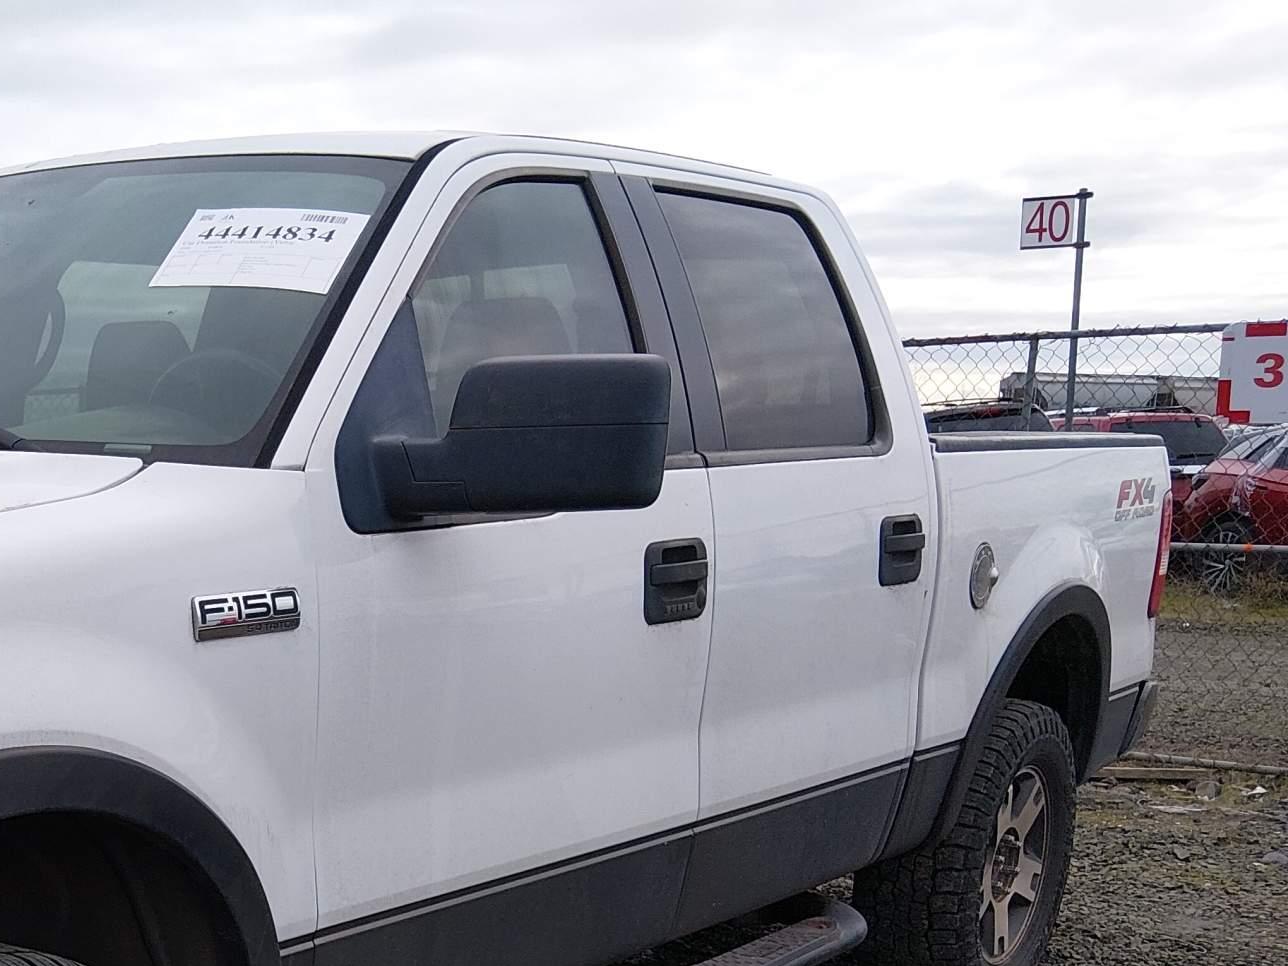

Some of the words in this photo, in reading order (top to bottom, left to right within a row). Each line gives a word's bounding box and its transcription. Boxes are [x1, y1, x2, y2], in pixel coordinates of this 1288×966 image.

[198, 225, 337, 243] 44414834
[1025, 200, 1070, 243] 40
[1116, 477, 1156, 509] FX4
[198, 590, 299, 625] F-150
